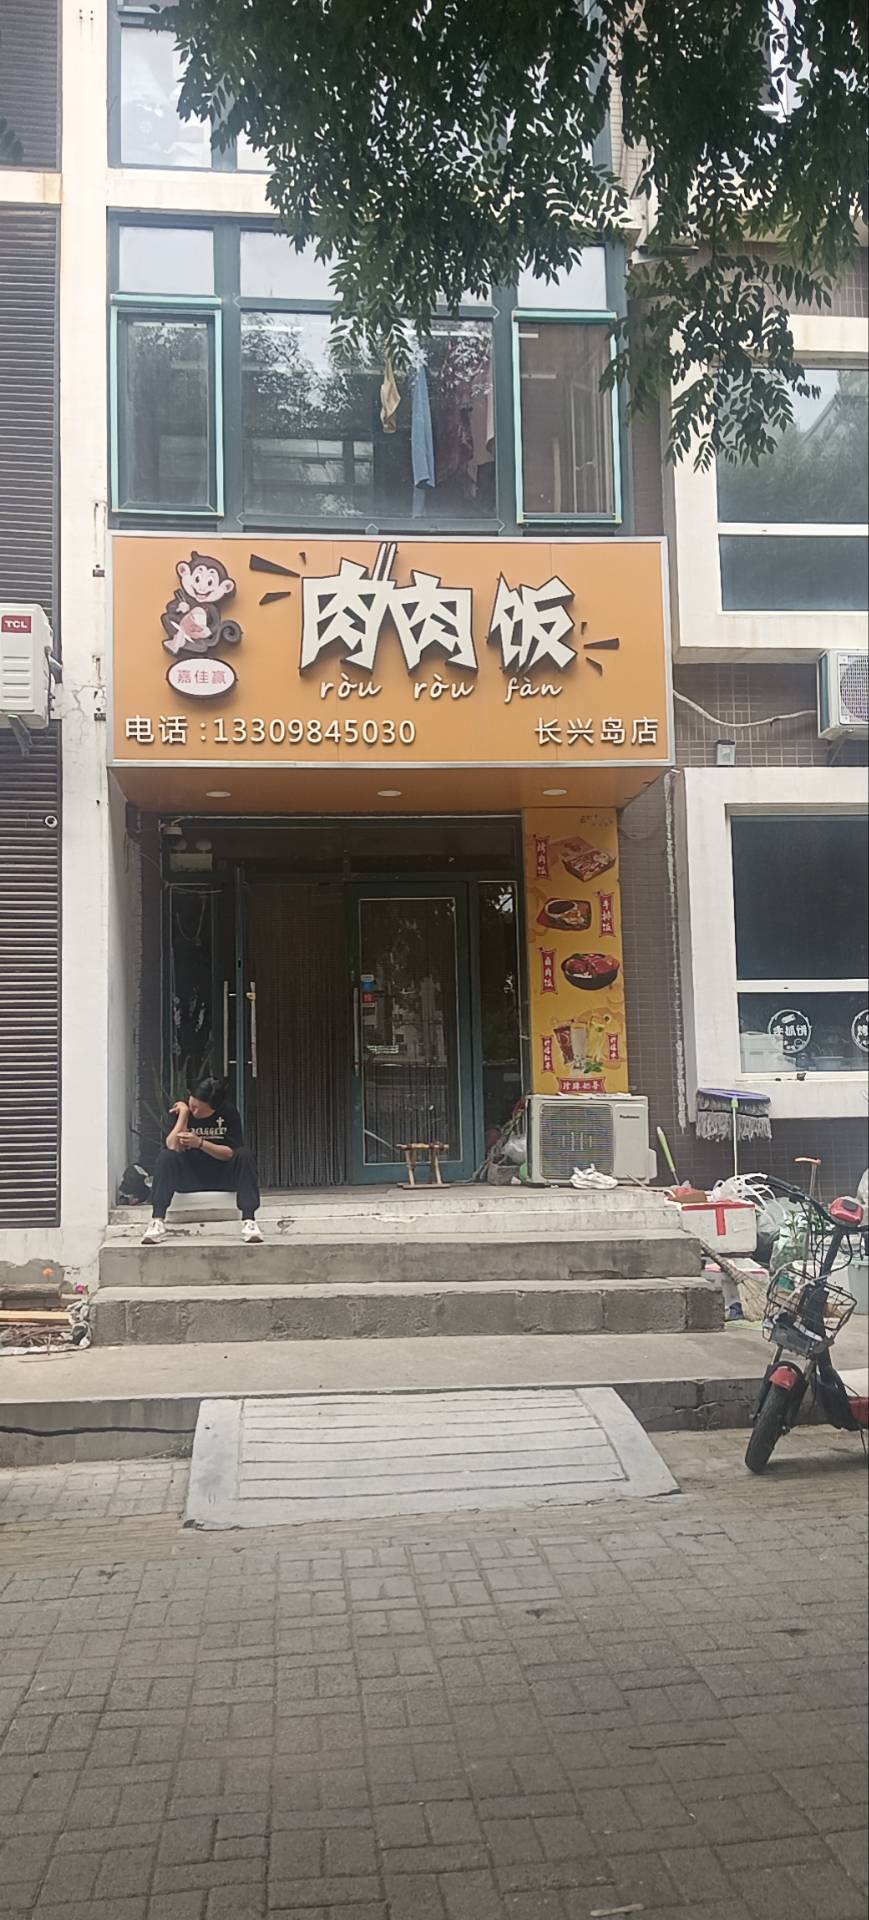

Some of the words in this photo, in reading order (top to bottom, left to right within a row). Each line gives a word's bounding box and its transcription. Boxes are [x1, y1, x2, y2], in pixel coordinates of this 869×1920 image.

[4, 619, 28, 629] TCL
[300, 557, 578, 675] 肉肉饭
[320, 673, 382, 699] ròu
[413, 673, 474, 699] ròu
[504, 677, 563, 704] fàn
[534, 717, 658, 744] 长兴岛店
